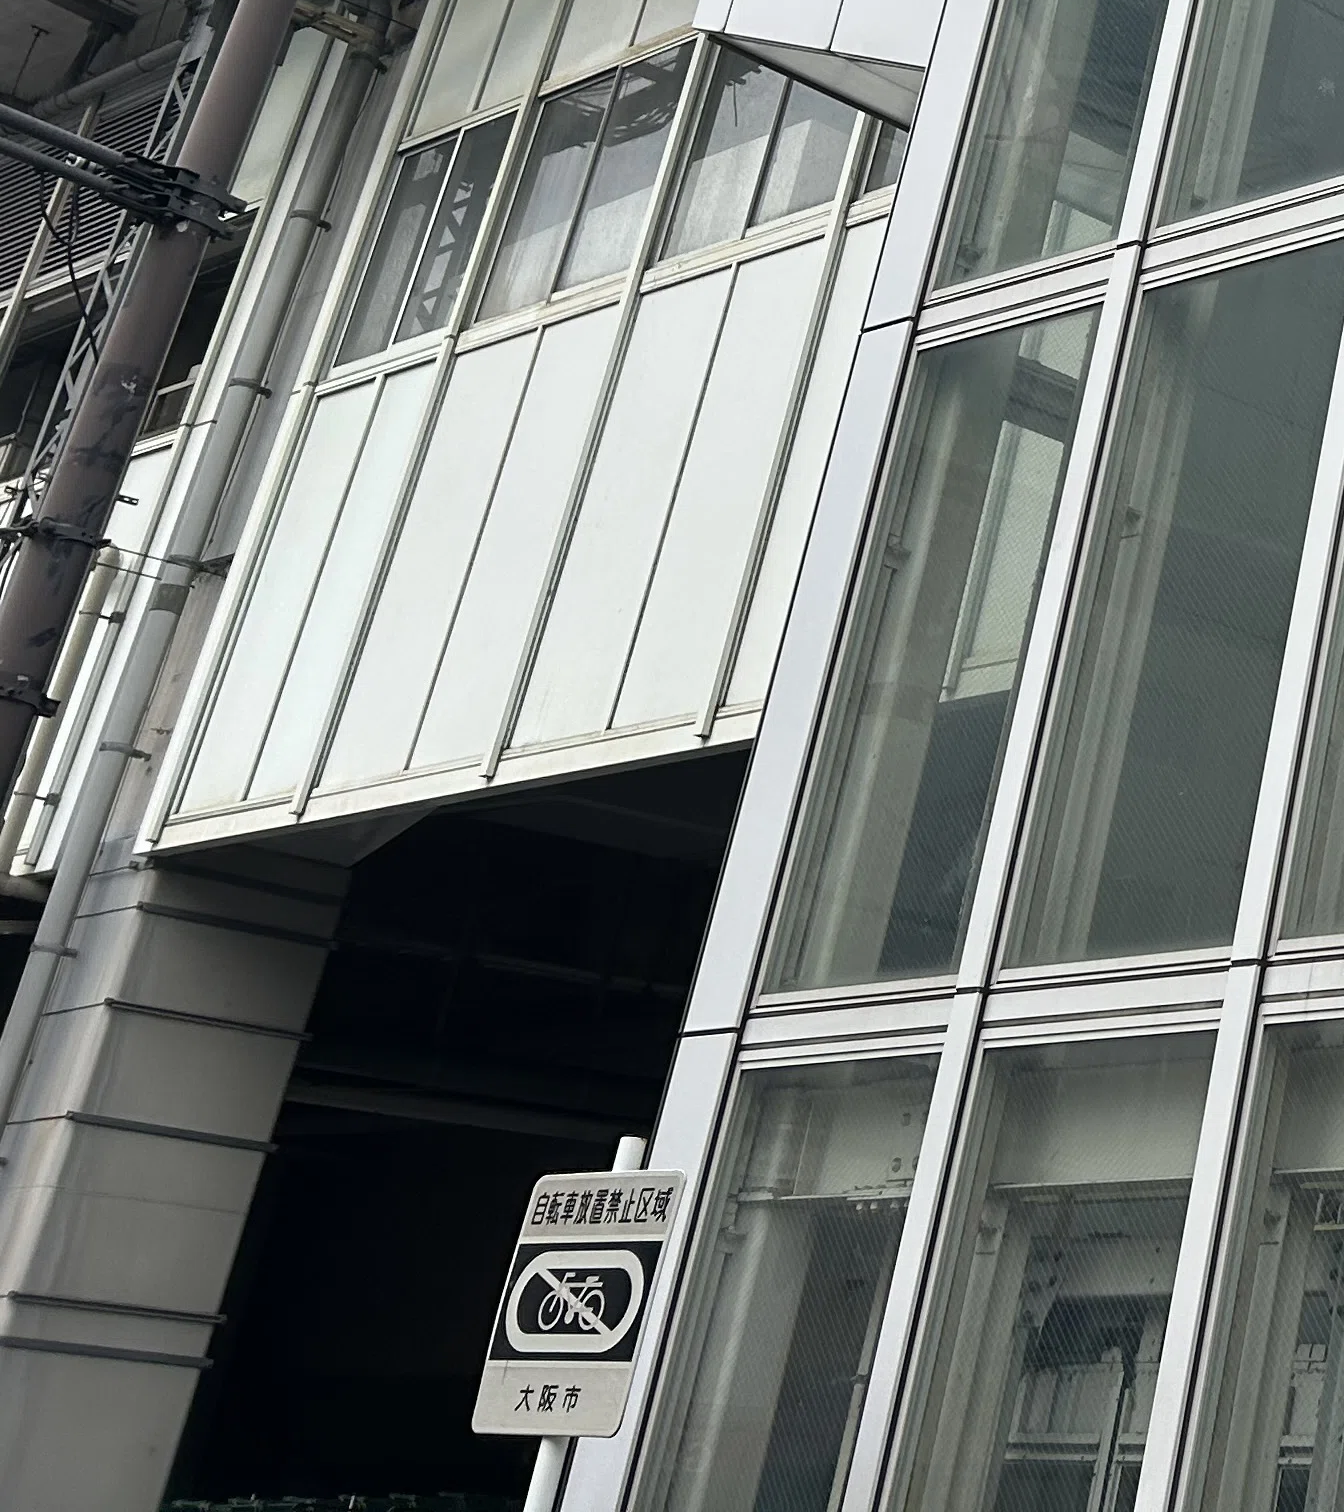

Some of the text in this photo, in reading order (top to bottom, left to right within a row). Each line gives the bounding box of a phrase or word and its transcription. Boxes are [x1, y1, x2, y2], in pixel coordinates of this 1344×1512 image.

[530, 1186, 674, 1226] 自転車放置禁止区域
[514, 1384, 582, 1413] 大阪市
